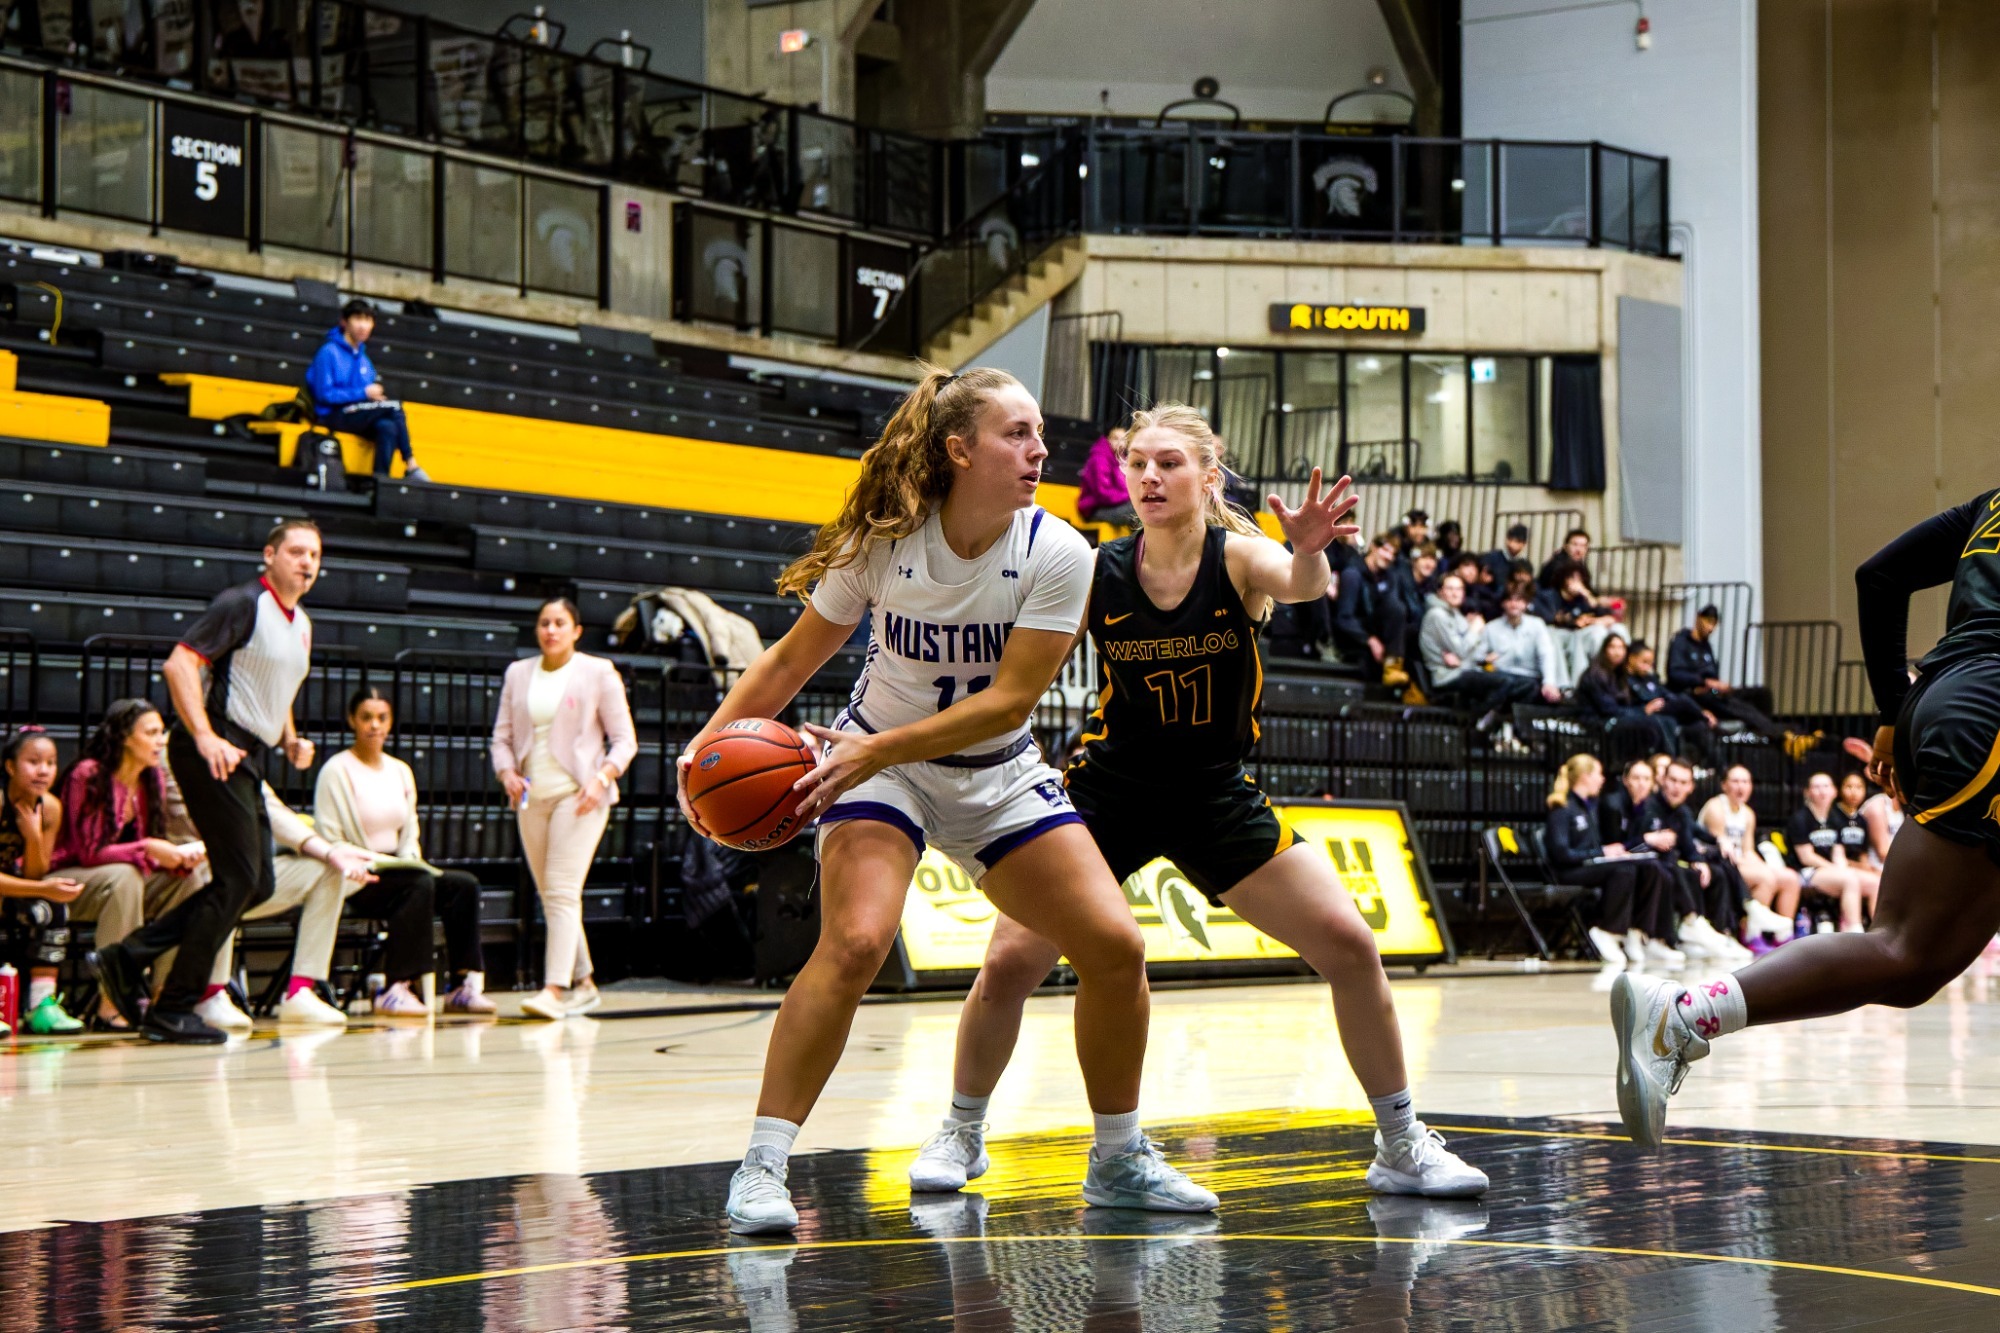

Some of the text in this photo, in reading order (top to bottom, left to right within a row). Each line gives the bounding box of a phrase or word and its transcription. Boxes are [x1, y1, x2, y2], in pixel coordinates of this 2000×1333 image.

[171, 135, 242, 167] SECTION
[195, 161, 219, 201] 5
[857, 267, 906, 290] SECTION
[872, 287, 890, 320] 7
[1323, 306, 1410, 331] SOUTH
[1144, 663, 1212, 726] 11
